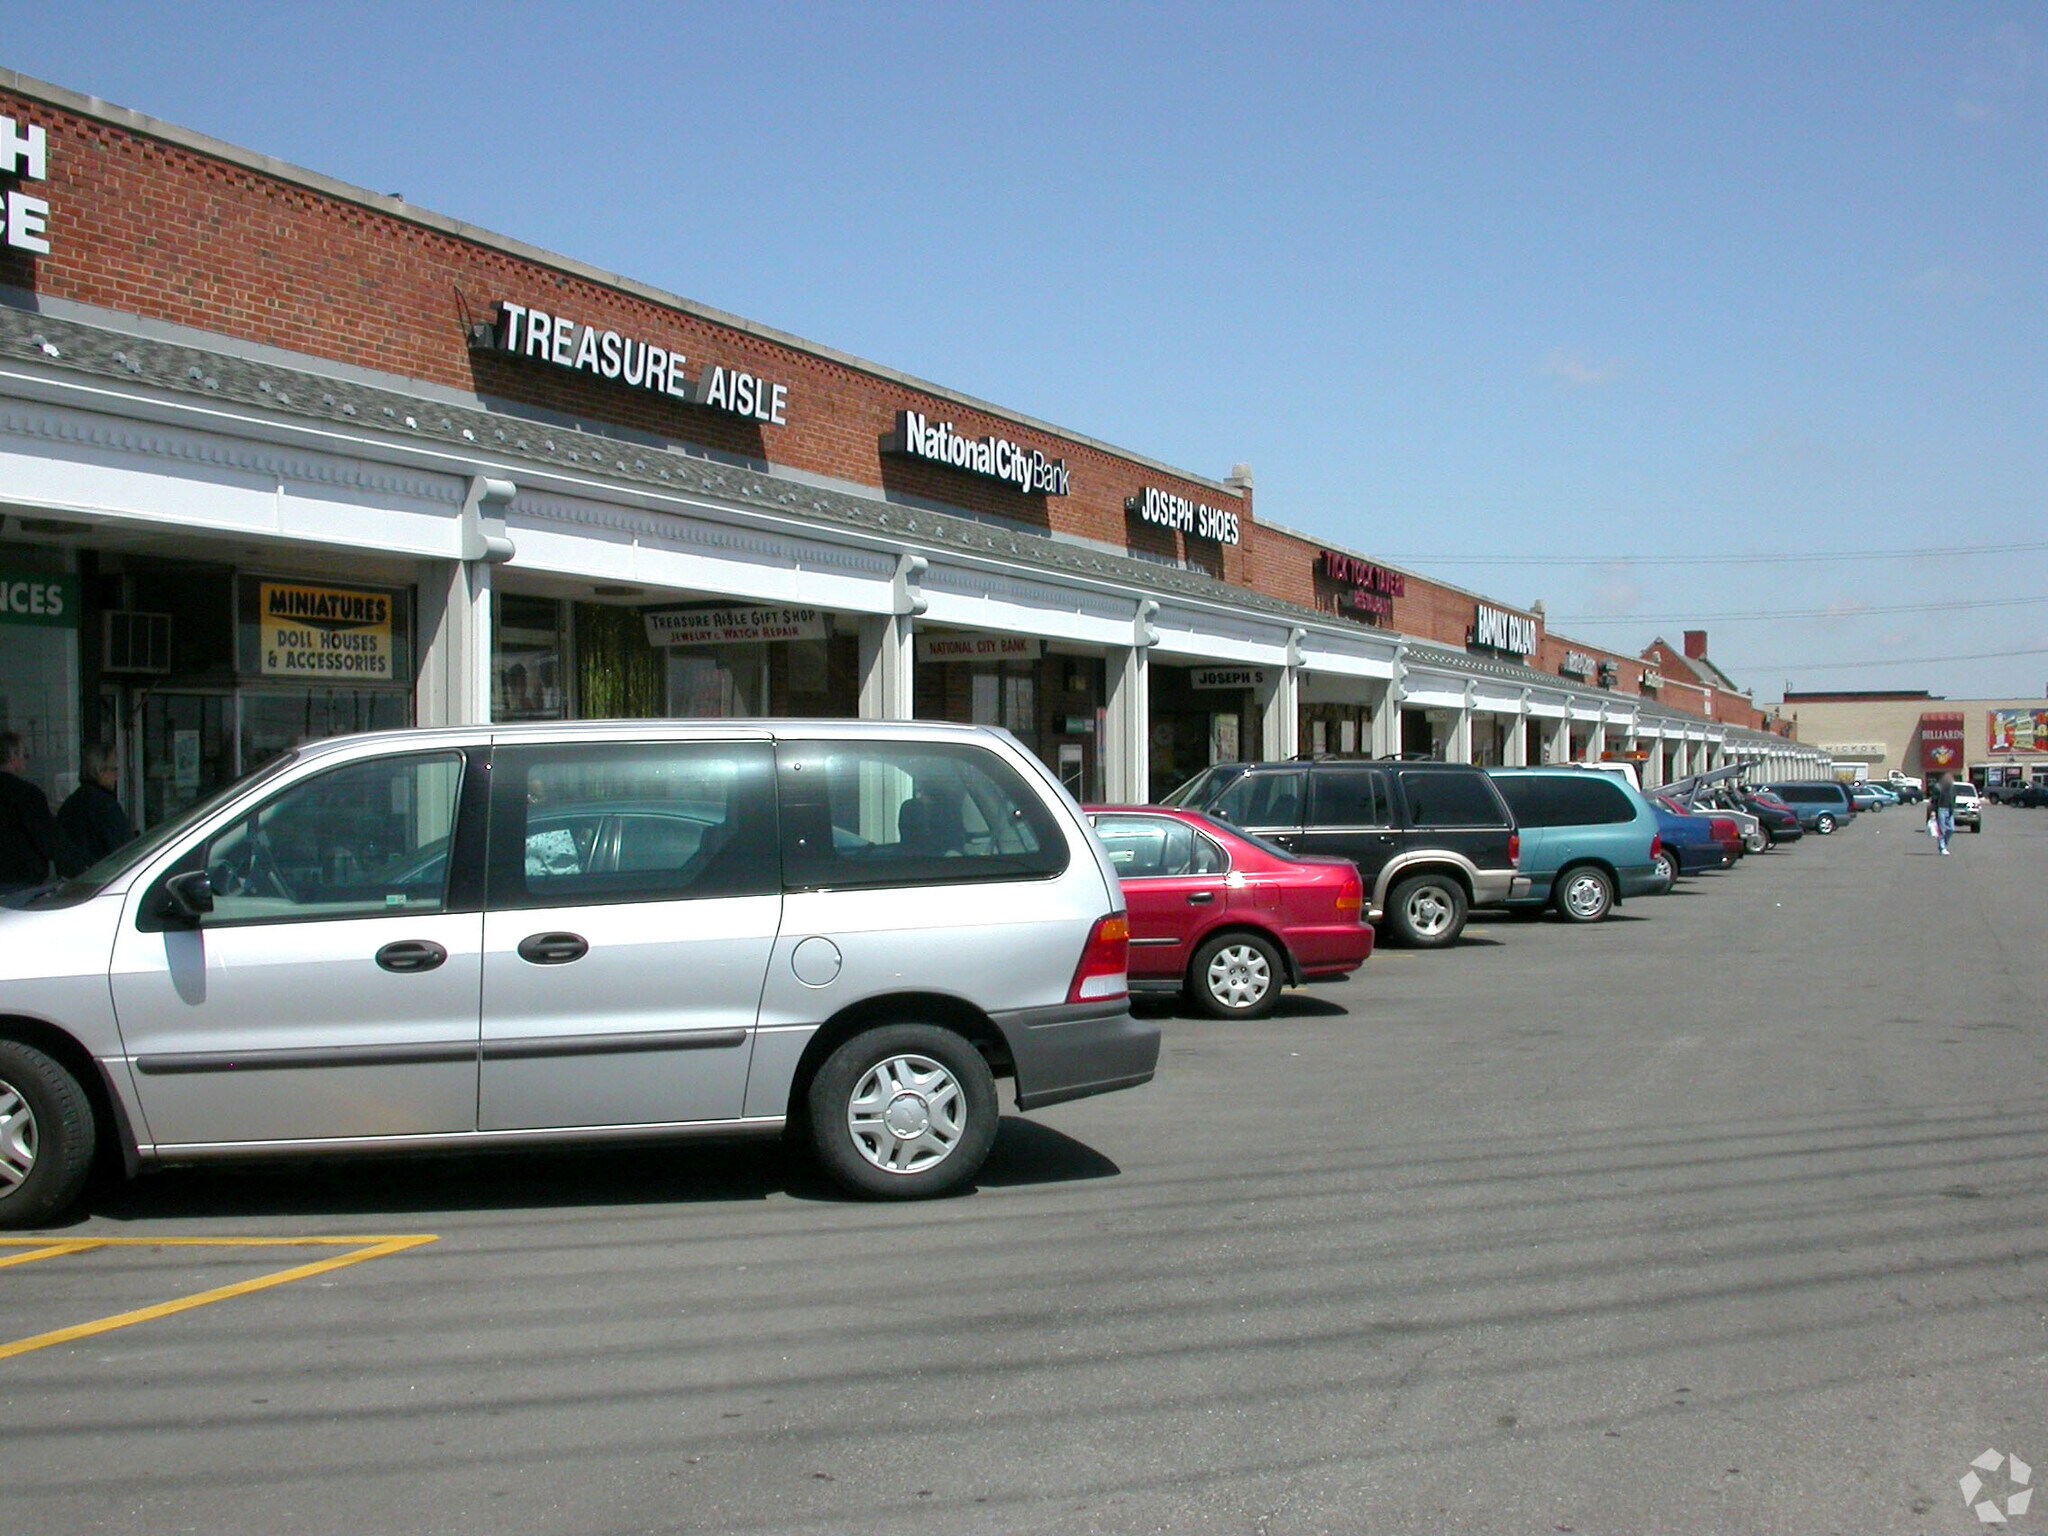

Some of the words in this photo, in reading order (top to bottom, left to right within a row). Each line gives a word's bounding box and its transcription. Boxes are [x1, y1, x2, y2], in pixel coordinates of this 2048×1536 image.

[0, 191, 51, 255] E
[502, 301, 687, 398] TREASURE
[706, 365, 789, 426] AISLE
[1141, 486, 1193, 532] JOSEPH
[1198, 503, 1239, 545] SHOES
[1326, 552, 1348, 582] TICK
[1350, 560, 1374, 590] TOCK
[1376, 567, 1405, 598] TAVERN
[269, 590, 387, 622] MINIATURES
[783, 609, 816, 625] SHOP
[723, 627, 760, 640] WATCH
[763, 626, 801, 638] REPAIR
[1478, 604, 1509, 650] FAMILY
[277, 629, 313, 648] DOLL
[320, 632, 378, 652] HOUSES
[929, 641, 973, 655] NATIONAL
[976, 640, 996, 654] CITY
[1002, 638, 1027, 652] BANK
[268, 650, 277, 669] &
[286, 650, 387, 672] ACCESSORIES
[1200, 672, 1250, 685] JOSEPH
[1921, 730, 1964, 740] BILLIARDS
[1825, 744, 1879, 754] HICKOK
